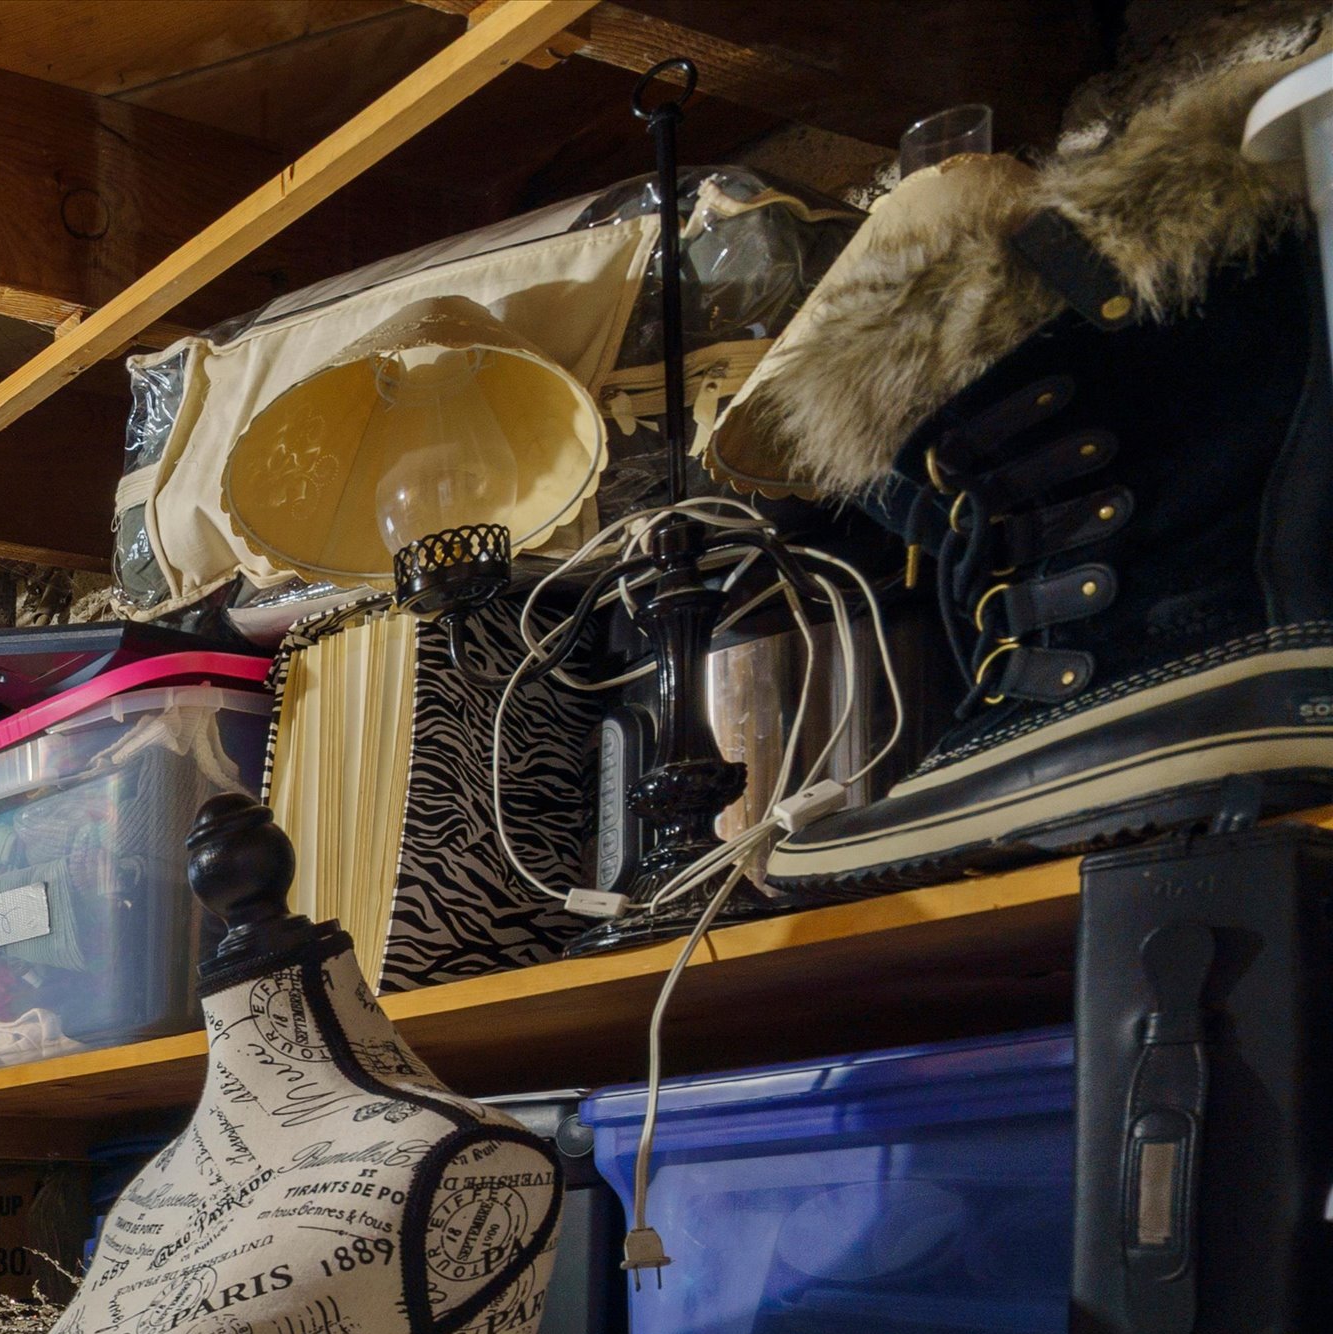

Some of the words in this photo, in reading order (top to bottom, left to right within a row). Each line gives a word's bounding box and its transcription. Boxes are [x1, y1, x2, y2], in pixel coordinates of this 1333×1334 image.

[284, 1180, 347, 1199] TIRANTS
[350, 1180, 373, 1196] DE
[0, 1195, 24, 1217] UP
[358, 1210, 393, 1233] tous
[171, 1263, 294, 1334] PARIS
[321, 1237, 395, 1278] 1889
